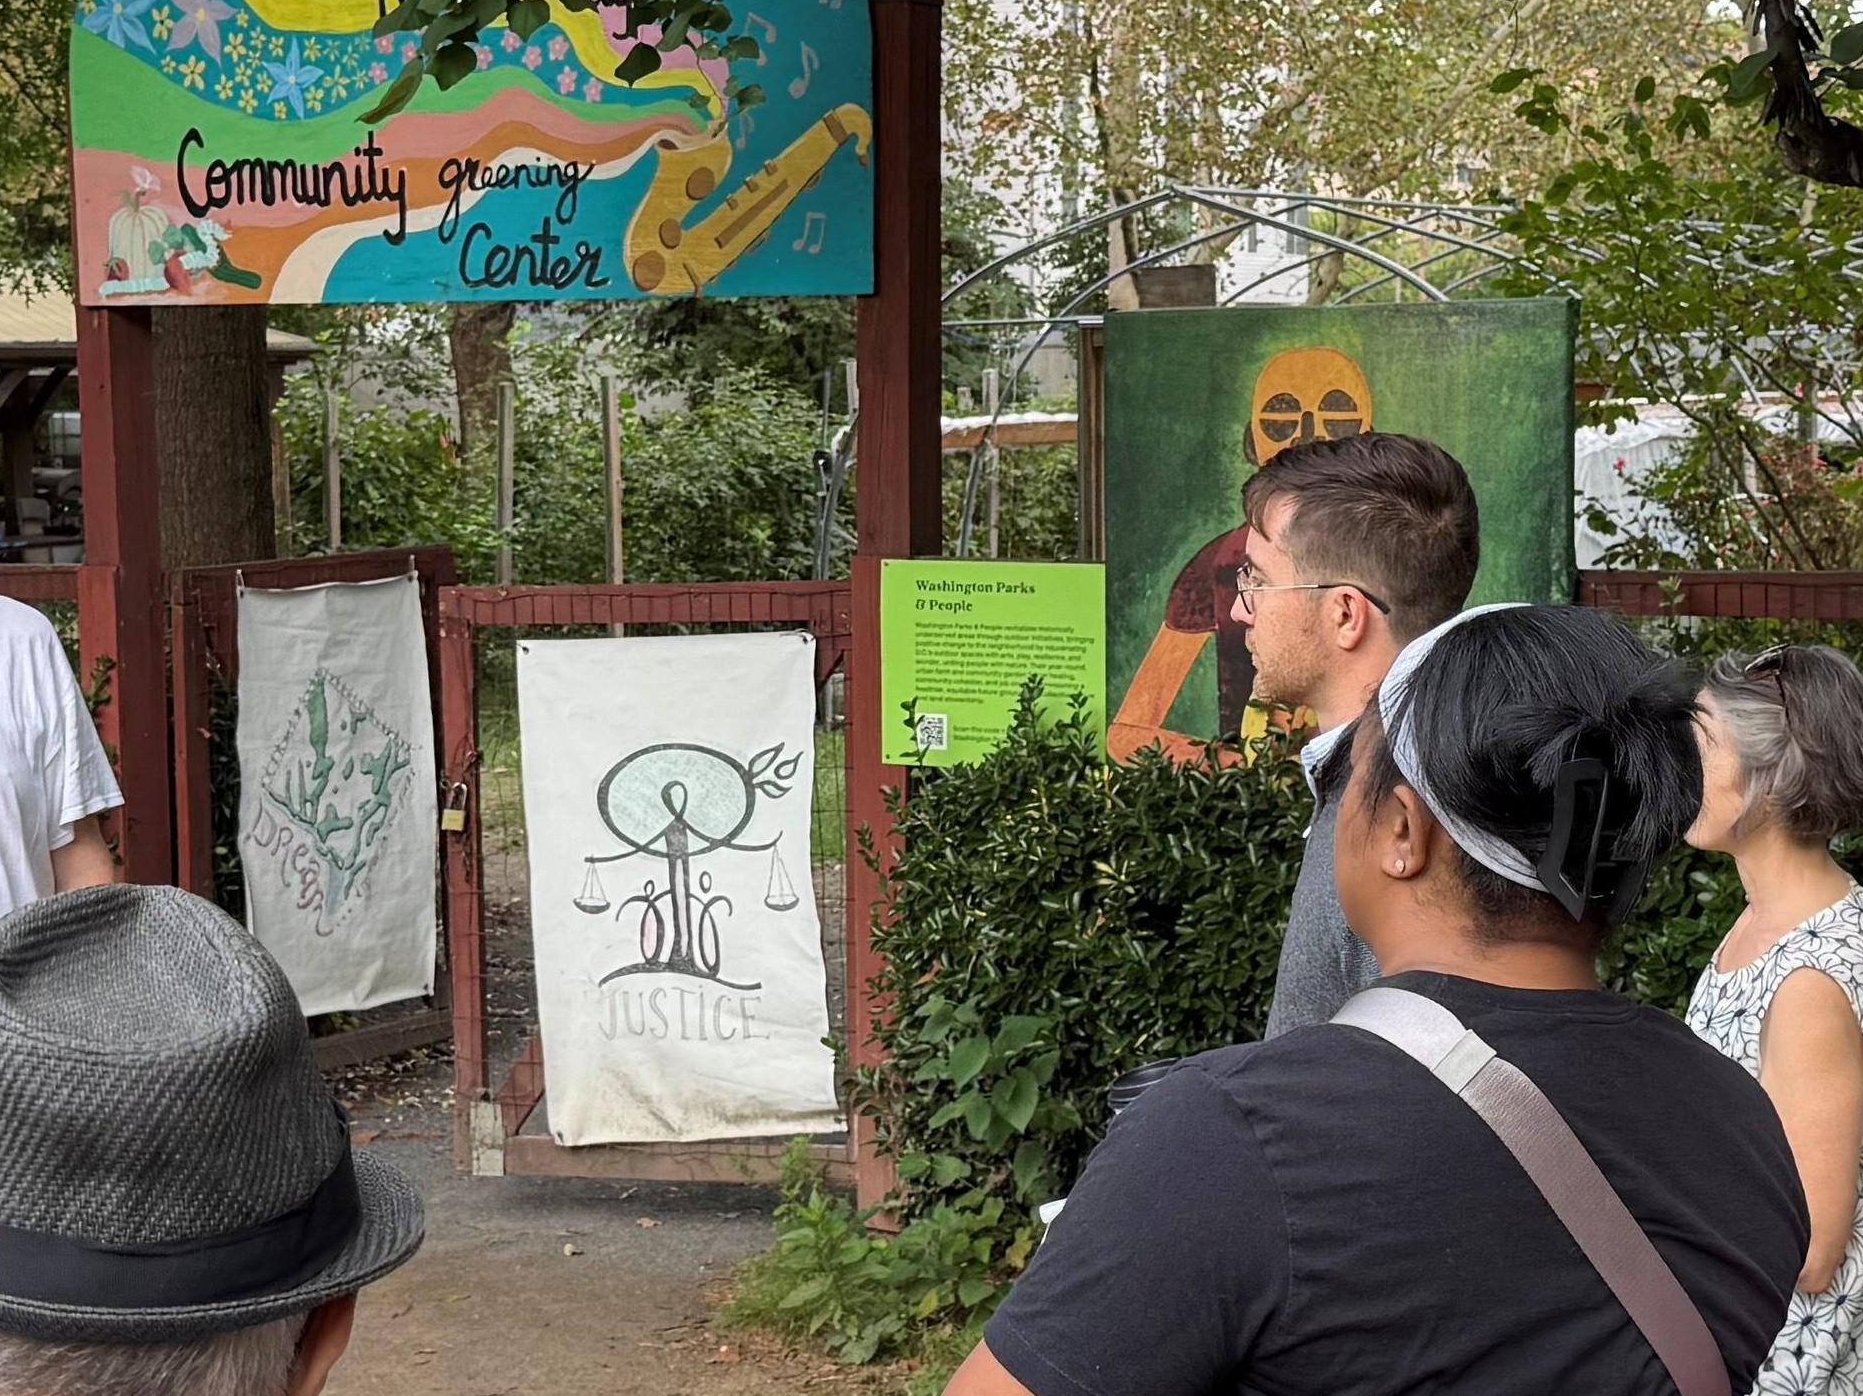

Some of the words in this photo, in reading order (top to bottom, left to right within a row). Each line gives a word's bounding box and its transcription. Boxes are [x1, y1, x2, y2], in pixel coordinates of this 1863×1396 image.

[177, 127, 407, 244] Community
[438, 156, 595, 244] greening
[458, 216, 609, 289] Center
[915, 580, 992, 595] Washington
[996, 582, 1035, 594] Parks
[929, 600, 973, 613] People
